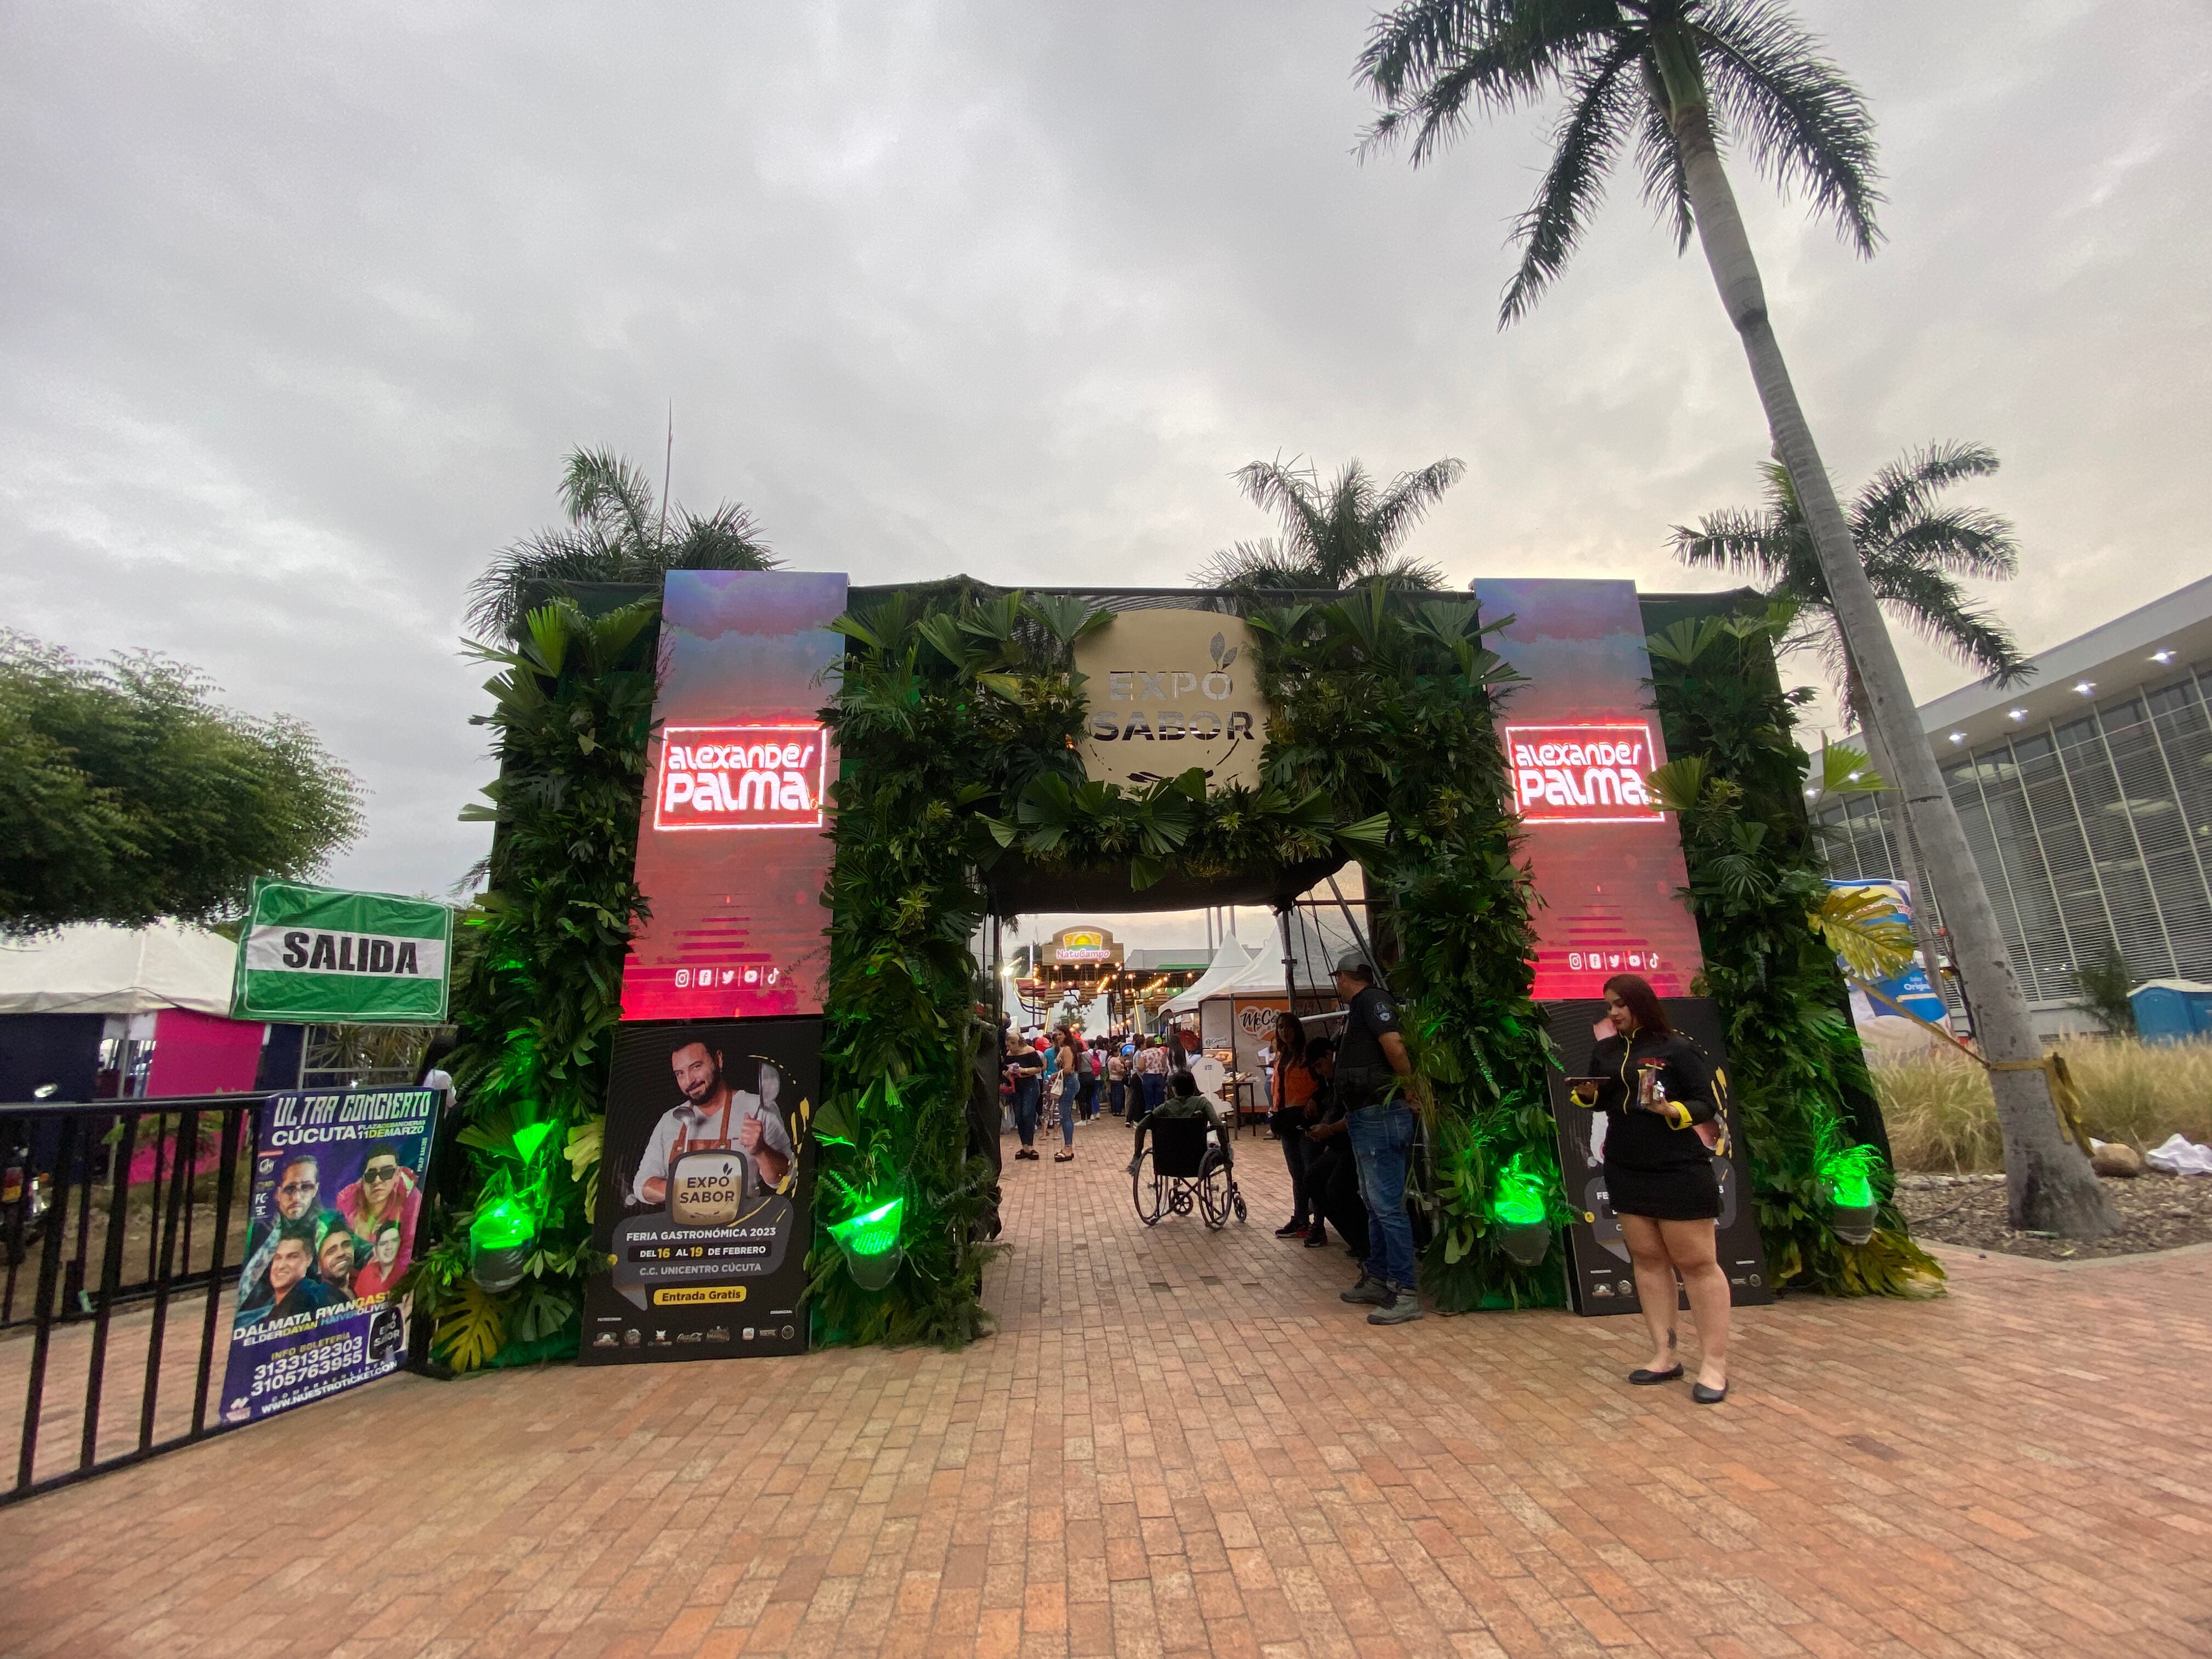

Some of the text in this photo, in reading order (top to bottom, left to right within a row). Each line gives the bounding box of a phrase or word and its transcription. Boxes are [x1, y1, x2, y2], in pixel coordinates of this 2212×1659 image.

[1110, 670, 1233, 701] EXPO
[1089, 711, 1255, 741] SABOR
[668, 744, 814, 770] alexander
[1515, 743, 1642, 767] alexander
[283, 931, 419, 974] SALIDA
[1057, 949, 1110, 961] NatuCampo
[338, 1091, 432, 1122] CONCIERTO
[272, 1126, 357, 1147] CÚCUTA
[687, 1176, 730, 1189] EXPO
[680, 1190, 735, 1204] SABOR
[627, 1227, 776, 1242] FERIA GASTRONÓMICA 2023
[640, 1246, 766, 1259] DEL 16 AL 19 DE FEBRERO
[640, 1262, 761, 1276] C.C. UNICENTRO CÚCUTA
[662, 1289, 741, 1302] Entrada Gratis
[233, 1312, 312, 1340] DALMATA
[253, 1336, 363, 1380] 3133132303
[272, 1348, 296, 1360] INFO
[251, 1350, 363, 1397] 3105763955
